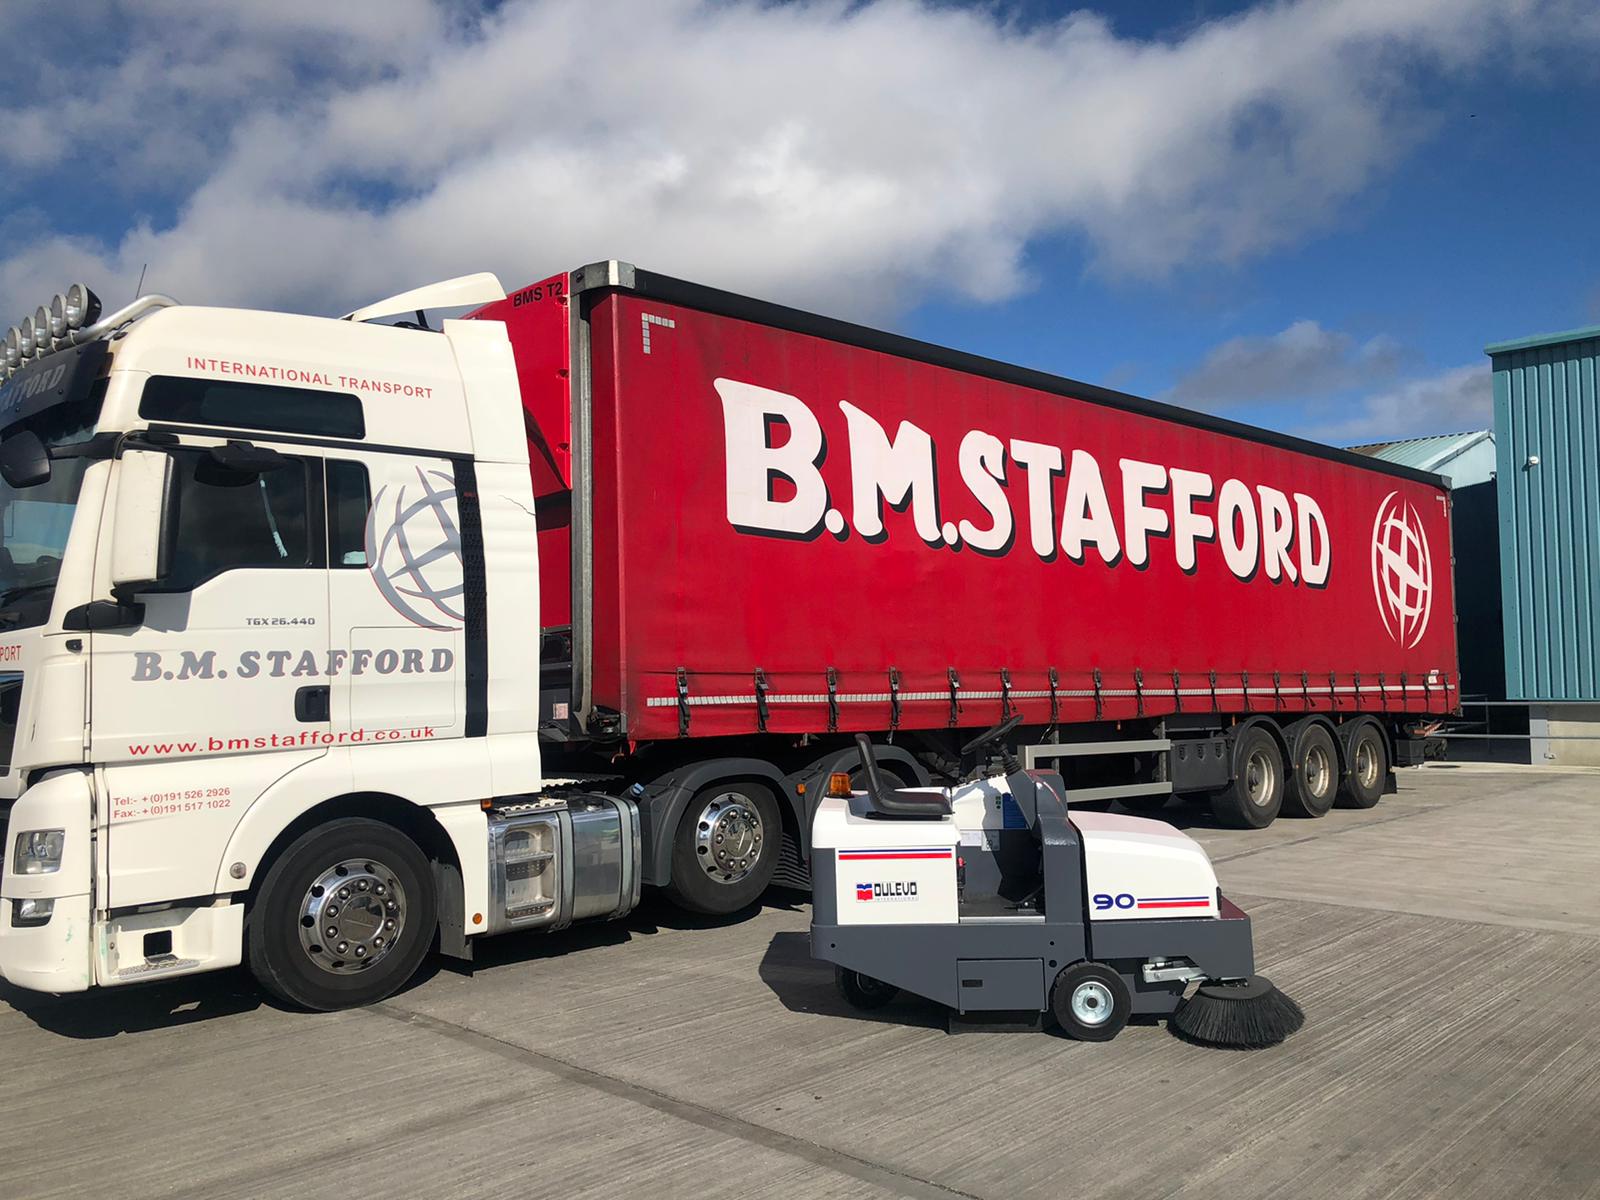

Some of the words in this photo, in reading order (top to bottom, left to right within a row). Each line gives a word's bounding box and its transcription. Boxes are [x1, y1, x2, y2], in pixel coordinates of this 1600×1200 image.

[513, 287, 543, 307] BMS
[546, 281, 563, 297] T2
[187, 356, 332, 386] INTERNATIONAL
[338, 376, 432, 399] TRANSPORT
[246, 617, 269, 626] TGX
[271, 617, 316, 626] 26.440
[131, 651, 228, 682] B.M.
[236, 648, 455, 678] STAFFORD
[128, 726, 435, 756] www.bmstafford.co.uk
[184, 789, 203, 799] 526
[206, 787, 230, 798] 2926
[184, 801, 203, 811] 517
[207, 799, 231, 809] 1022
[874, 881, 918, 897] DULEVO
[1093, 893, 1135, 910] 90
